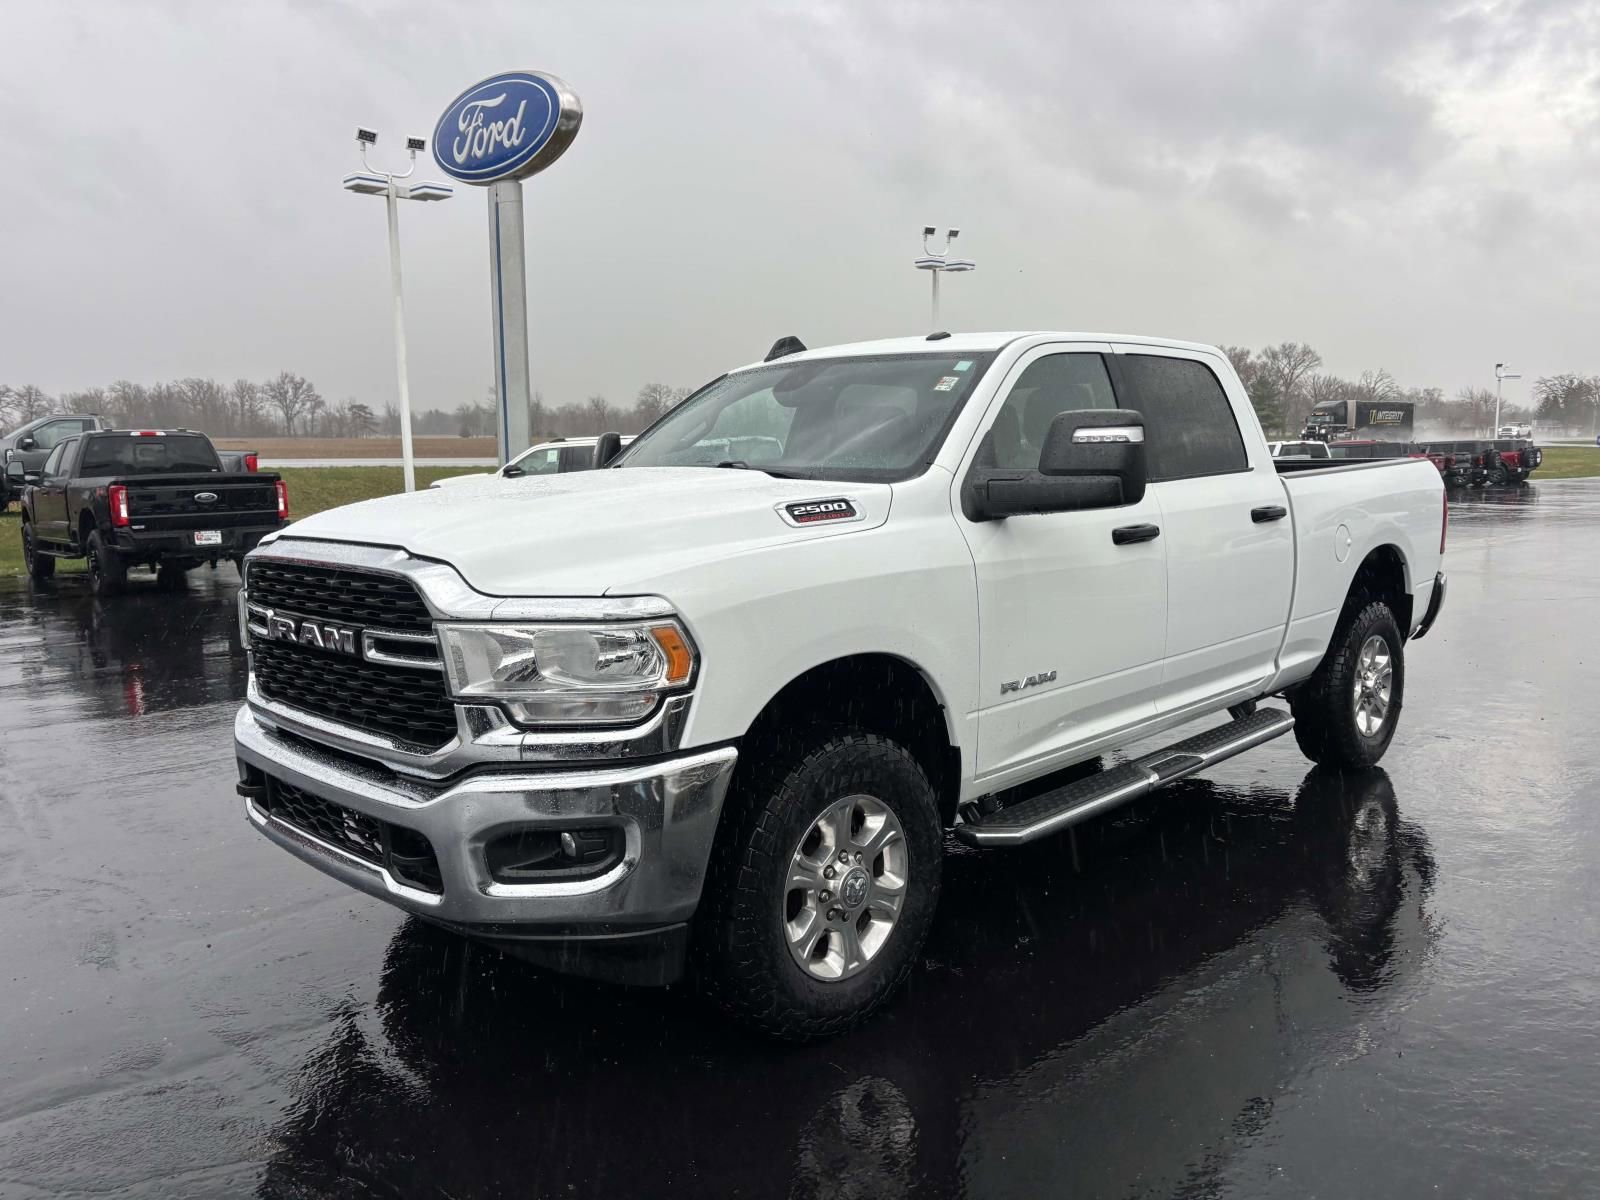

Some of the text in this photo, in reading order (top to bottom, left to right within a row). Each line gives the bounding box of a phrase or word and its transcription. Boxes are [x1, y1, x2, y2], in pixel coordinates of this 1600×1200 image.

[453, 93, 527, 164] Ford
[792, 502, 848, 515] 2500
[269, 616, 355, 653] RAM
[1000, 670, 1057, 695] RAM
